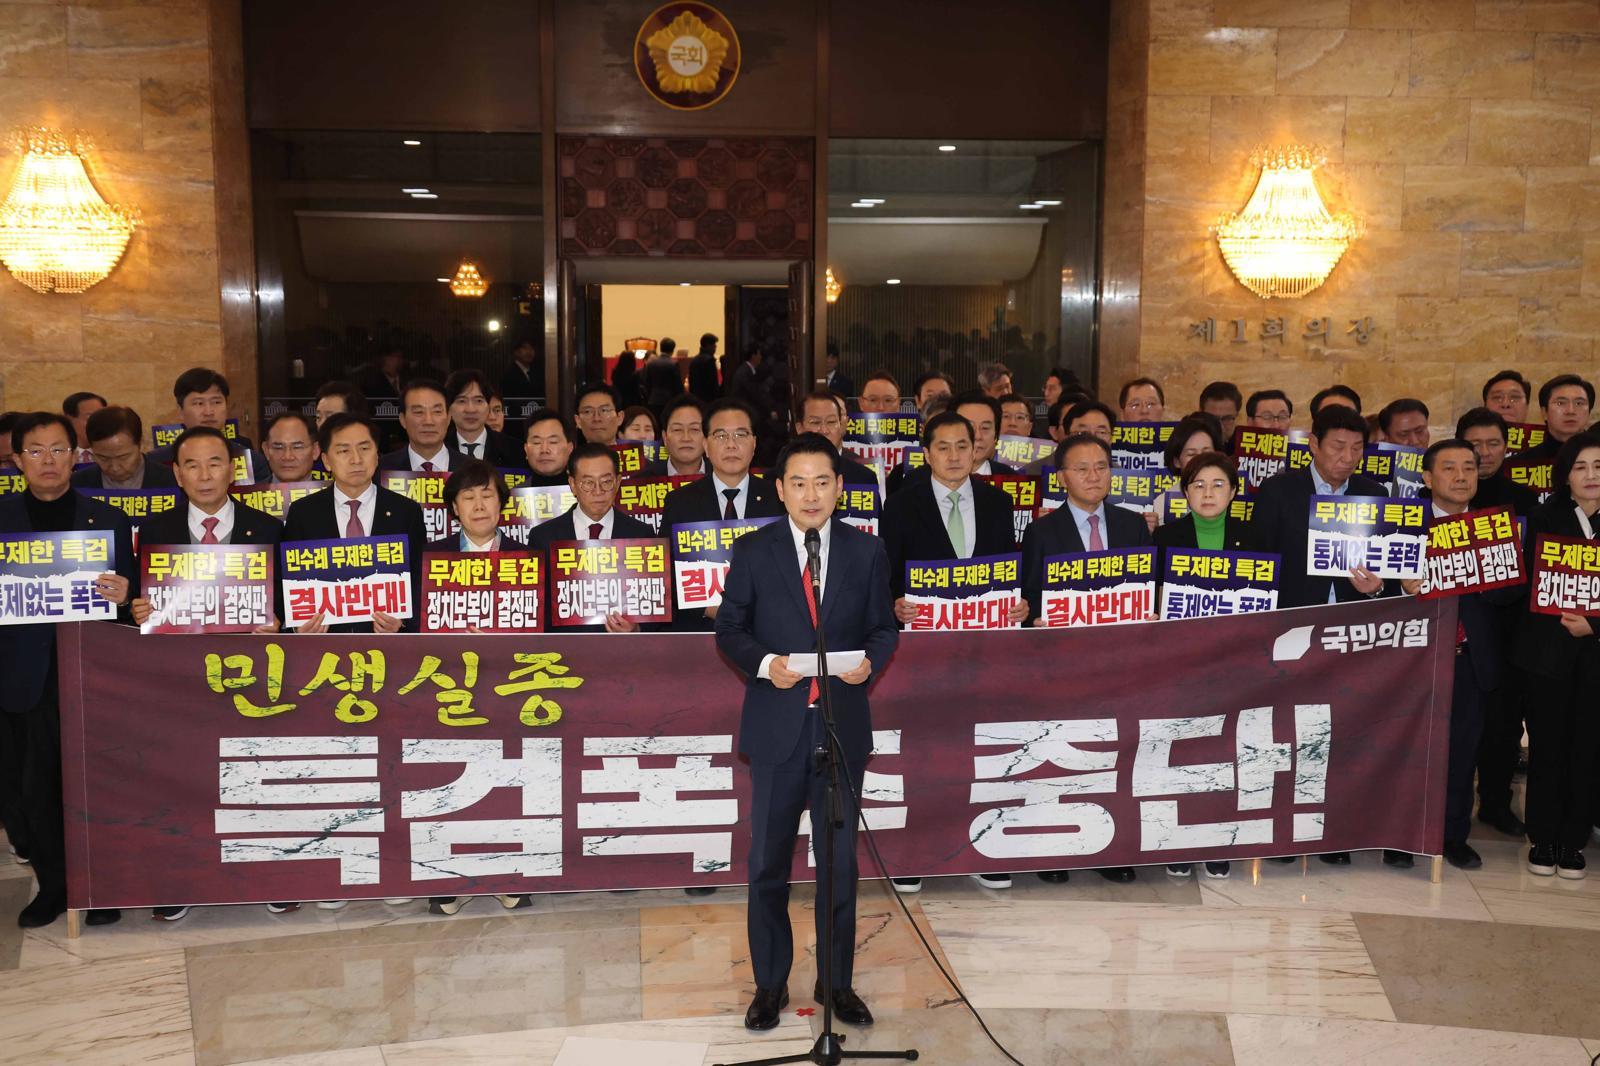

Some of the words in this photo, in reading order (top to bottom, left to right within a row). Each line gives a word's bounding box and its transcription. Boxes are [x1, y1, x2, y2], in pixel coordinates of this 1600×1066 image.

[671, 45, 703, 66] 국회
[222, 423, 236, 439] 검
[868, 418, 896, 435] 무제한
[898, 418, 917, 435] 특검
[1240, 432, 1288, 457] 무제한
[617, 448, 640, 472] 검
[1366, 456, 1391, 475] 특검
[850, 491, 874, 511] 특검
[1002, 480, 1036, 506] 특검
[1126, 477, 1150, 496] 특검
[232, 489, 284, 516] 제한
[1316, 502, 1378, 525] 무제한
[1384, 504, 1424, 527] 특검
[678, 529, 718, 554] 빈수레
[1426, 520, 1470, 550] 제한
[1473, 512, 1513, 542] 특검
[0, 540, 54, 564] 제한
[62, 538, 108, 562] 특검
[286, 548, 328, 572] 빈수레
[332, 544, 374, 568] 무제한
[376, 542, 404, 566] 특검
[556, 546, 619, 576] 무제한
[624, 544, 664, 573] 특검
[1388, 542, 1420, 574] 폭력
[1479, 542, 1520, 584] 결정판
[1541, 541, 1600, 572] 무제한
[148, 552, 218, 582] 무제한
[224, 552, 267, 580] 특검
[428, 558, 493, 587] 무제한
[498, 557, 539, 585] 특검
[910, 567, 950, 588] 빈수레
[952, 563, 990, 588] 무제한
[993, 560, 1018, 582] 특검
[1047, 559, 1084, 584] 빈수레
[1086, 555, 1124, 579] 무제한
[1126, 553, 1152, 575] 특검
[1170, 554, 1232, 580] 무제한
[1236, 558, 1275, 582] 특검
[0, 581, 64, 618] 제없는
[147, 585, 220, 626] 정치보복의
[224, 585, 268, 625] 결정판
[289, 580, 406, 621] 결사반대!
[427, 590, 494, 630] 정치보복의
[498, 590, 539, 628] 결정판
[557, 578, 622, 618] 정치보복의
[626, 578, 666, 616] 결정판
[911, 596, 1016, 630] 결사반대!
[1047, 590, 1150, 628] 결사반대!
[1321, 618, 1430, 654] 국민의힘
[205, 643, 584, 726] 민생실종
[968, 703, 1332, 858] 중단!
